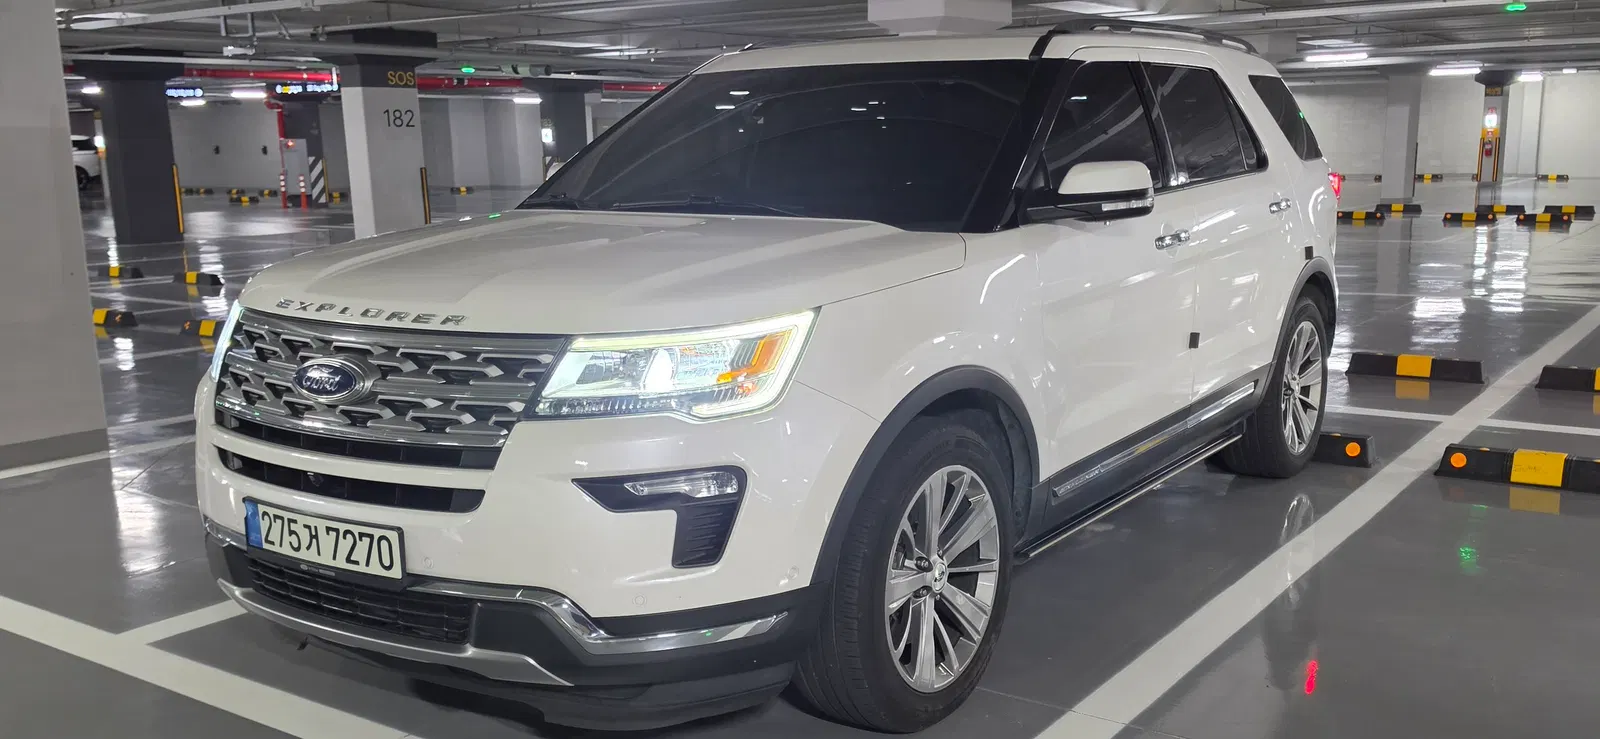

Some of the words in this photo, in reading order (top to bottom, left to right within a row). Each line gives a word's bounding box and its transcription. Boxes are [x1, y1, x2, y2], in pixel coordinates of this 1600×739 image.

[387, 71, 415, 86] SOS
[383, 109, 416, 128] 182
[276, 297, 468, 326] EXPLORER
[302, 365, 342, 392] Ford
